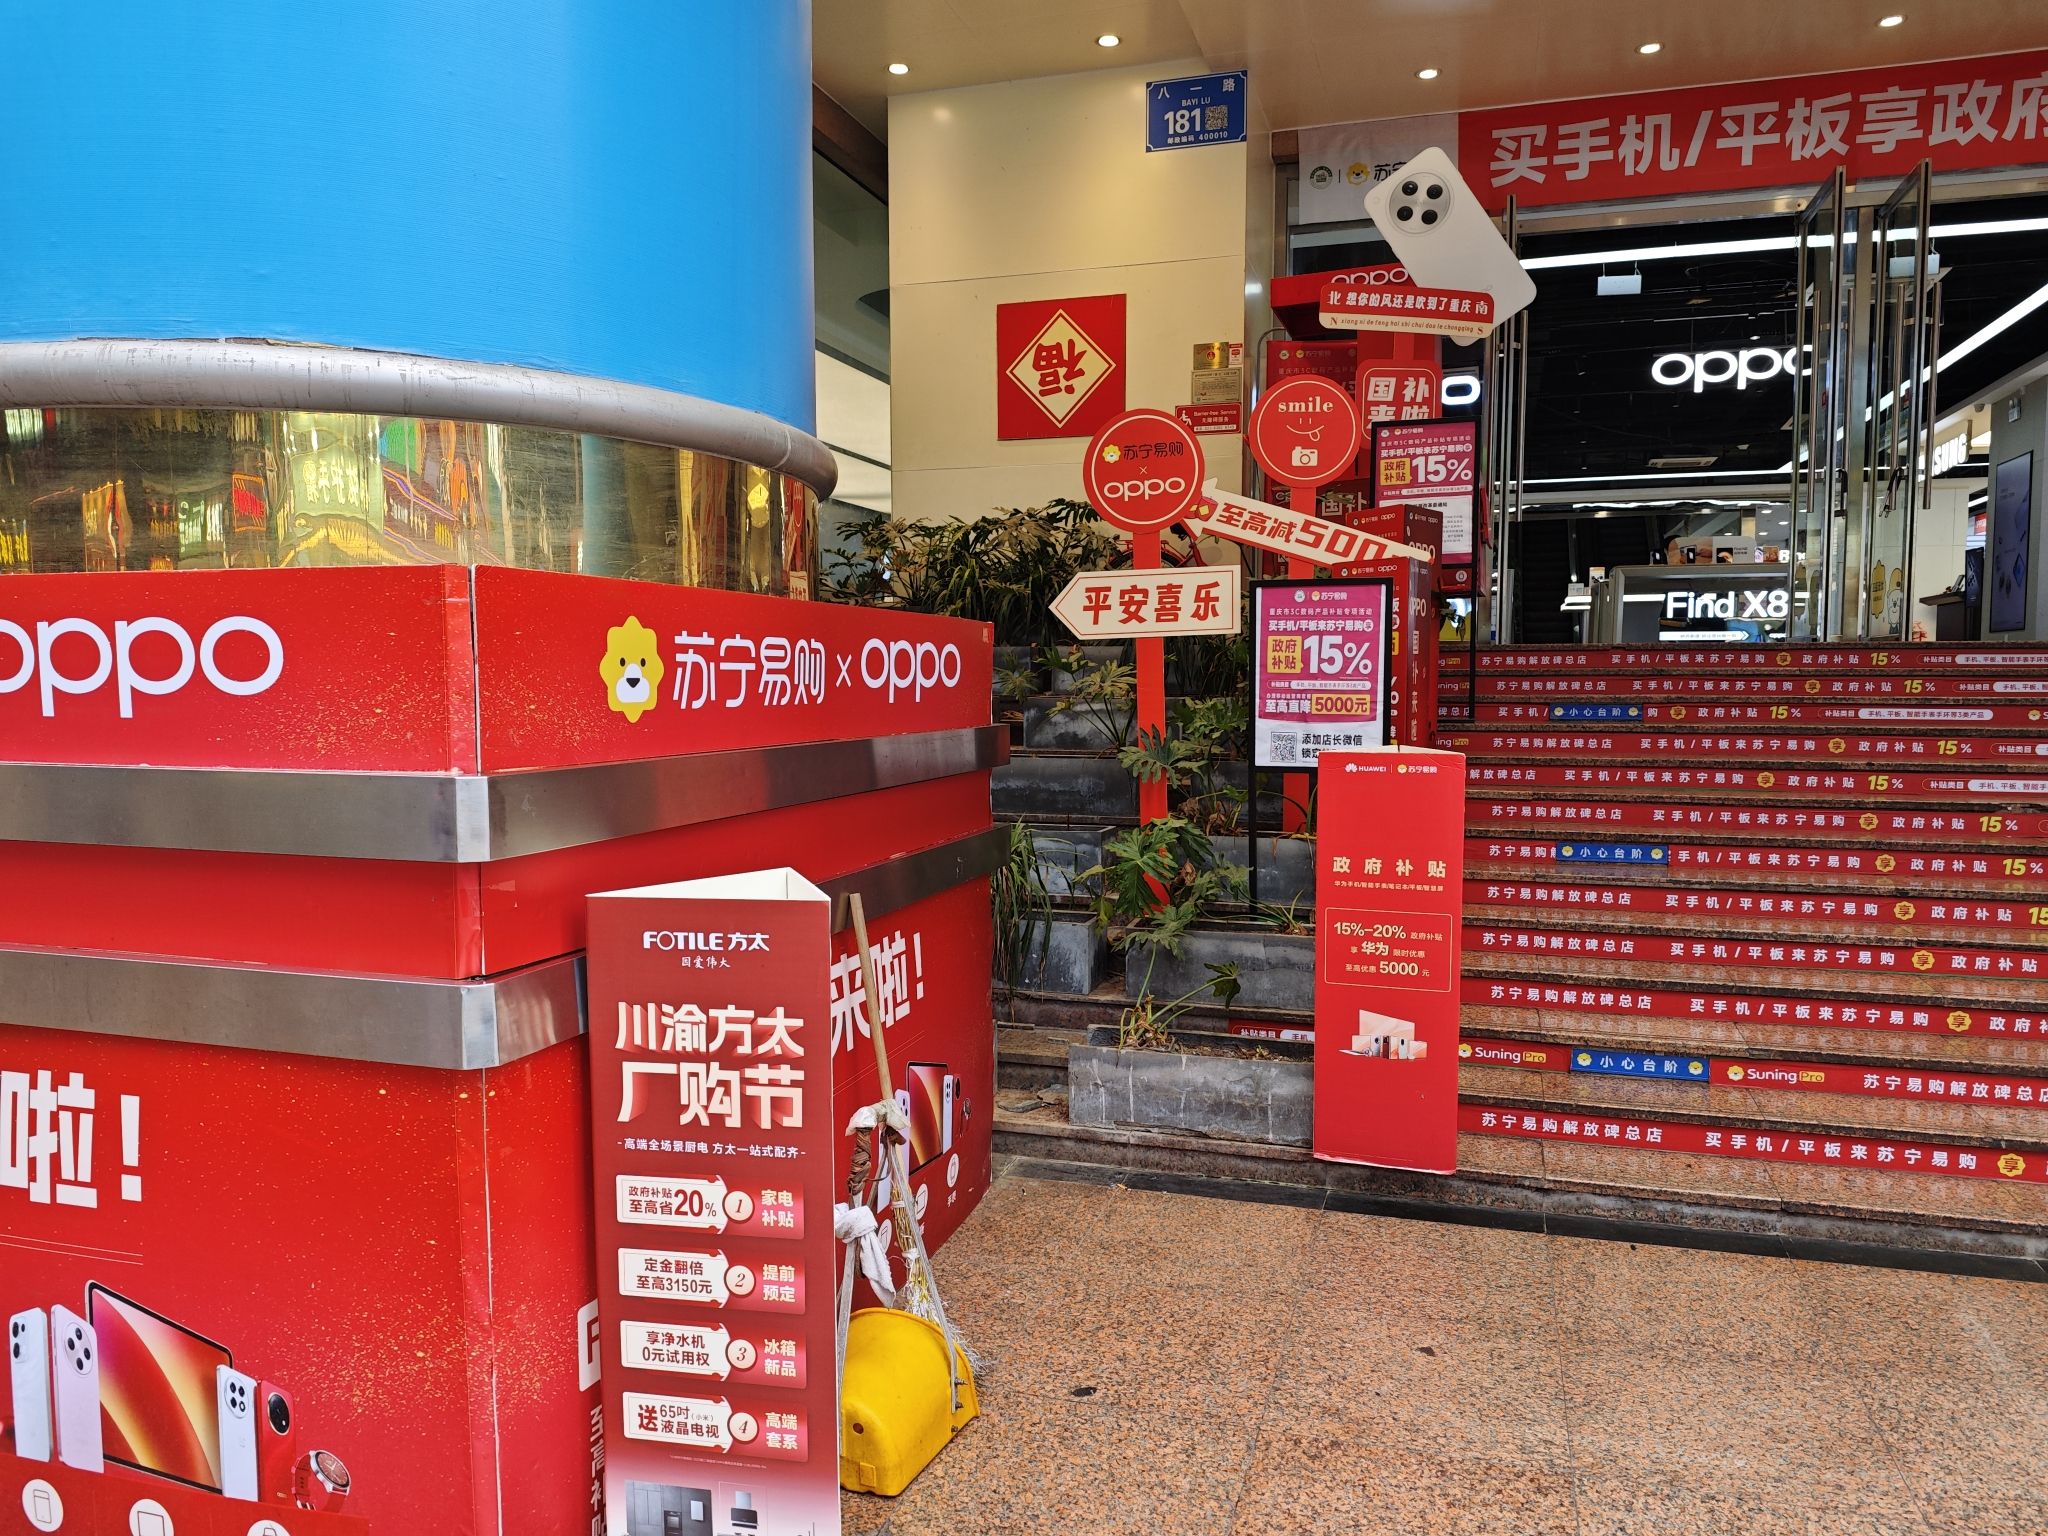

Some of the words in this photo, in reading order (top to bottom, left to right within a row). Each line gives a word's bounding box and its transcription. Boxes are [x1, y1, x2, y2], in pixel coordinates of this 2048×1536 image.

[1157, 77, 1236, 100] 八一路
[1181, 98, 1198, 107] BAYI
[1201, 96, 1211, 105] LU
[1164, 108, 1201, 135] 181
[1489, 72, 2048, 189] 买手机/平板享政府
[1167, 135, 1195, 145] 邮政编码
[1198, 130, 1228, 141] 400010
[1328, 290, 1342, 306] 北
[1346, 291, 1472, 314] 想你的风还是吹到了重庆
[1475, 300, 1489, 316] 南
[1330, 316, 1338, 326] N
[1477, 326, 1485, 335] S
[1032, 338, 1087, 398] 福
[1367, 376, 1430, 403] 国补
[1278, 396, 1334, 413] smile
[1123, 440, 1185, 462] 苏宁易购
[1384, 460, 1406, 471] 政府
[1411, 454, 1472, 483] 15%
[1384, 472, 1406, 482] 补贴
[1103, 477, 1186, 504] oppo
[1378, 564, 1398, 573] oppo
[1083, 581, 1222, 626] 平安喜乐
[1320, 591, 1348, 601] 苏宁易购
[1667, 590, 1735, 619] Find
[1742, 589, 1789, 618] X8
[1269, 607, 1373, 616] 重庆市3C数码产品补贴专项活动
[1268, 620, 1363, 632] 买手机/平板来苏宁易购
[1271, 655, 1297, 670] 补贴
[1272, 638, 1297, 653] 政府
[1303, 634, 1373, 675] 15%
[1482, 655, 1588, 666] 苏宁易购解放碑总店
[1611, 653, 1765, 665] 买手机/平板来苏宁易购
[1802, 654, 1860, 664] 政府补贴
[1870, 653, 1901, 666] 15%
[672, 630, 826, 710] 苏宁易购
[860, 638, 961, 703] oppo
[1496, 680, 1607, 691] 苏宁易购解放碑总店
[1632, 680, 1793, 691] 买手机/平板来苏宁易购
[1832, 681, 1893, 692] 政府补贴
[1904, 679, 1936, 693] 15%
[1265, 699, 1312, 714] 至高直降
[1314, 696, 1368, 713] 5000元
[1569, 707, 1622, 717] 小心台阶
[1698, 706, 1758, 718] 政府补贴
[1769, 706, 1801, 720] 15%
[1824, 709, 1855, 718] 补贴类目
[1301, 733, 1363, 746] 添加店长微信
[1493, 737, 1613, 749] 苏宁易购解放碑总店
[1640, 738, 1816, 751] 买手机/平板来苏宁易购
[1858, 741, 1924, 753] 政府补贴
[1936, 740, 1972, 755] 15%
[1998, 745, 2032, 754] 补贴类目
[1408, 765, 1438, 774] 苏宁易购
[1564, 770, 1744, 785] 买手机/平板来苏宁易购
[1787, 775, 1855, 789] 政府补贴
[1868, 775, 1904, 790] 15%
[1930, 780, 1965, 789] 补贴类目
[1491, 804, 1623, 820] 苏宁易购解放碑总店
[1652, 808, 1845, 827] 买手机/平板来苏宁易购
[1892, 816, 1965, 830] 政府补贴
[1979, 816, 2018, 833] 15%
[1580, 846, 1643, 859] 小心台阶
[1669, 848, 1861, 869] 手机/平板来苏宁易购
[1910, 859, 1987, 873] 政府补贴
[2002, 858, 2044, 876] 15%
[1333, 856, 1447, 878] 政府补贴
[1487, 886, 1632, 906] 苏宁易购解放碑总店
[1665, 894, 1879, 916] 买手机/平板来苏宁易购
[1931, 906, 2013, 922] 政府补贴
[643, 930, 723, 951] FOTILE
[727, 931, 770, 952] 方太
[1410, 931, 1443, 942] 政府补贴
[1361, 941, 1390, 956] 华为
[1393, 949, 1426, 959] 限时优惠
[1482, 932, 1635, 954] 苏宁易购解放碑总店
[1670, 942, 1896, 966] 买手机/平板来苏宁易购
[1951, 955, 2038, 974] 政府补贴
[1345, 963, 1377, 973] 至高优惠
[1379, 960, 1419, 976] 5000
[1421, 969, 1430, 977] 元
[1491, 985, 1653, 1010] 苏宁易购解放碑总店
[1690, 998, 1929, 1027] 买手机/平板来苏宁易购
[614, 1001, 805, 1057] 川渝方太
[1475, 1046, 1521, 1064] Suning
[1523, 1052, 1545, 1063] Pro
[1600, 1056, 1678, 1075] 小心台阶
[1747, 1067, 1798, 1084] Suning
[1800, 1071, 1825, 1083] Pro
[617, 1061, 805, 1130] 厂购节
[1482, 1112, 1663, 1143] 苏宁易购解放碑总店
[1705, 1132, 1977, 1170] 买手机/平板来苏宁易购
[628, 1186, 673, 1199] 政府补贴
[735, 1199, 743, 1214] 1
[761, 1189, 793, 1207] 家电
[761, 1210, 794, 1228] 补贴
[644, 1257, 703, 1275] 定金翻倍
[735, 1273, 745, 1287] 2
[762, 1264, 795, 1282] 提前
[636, 1275, 713, 1294] 至高3150元
[763, 1284, 796, 1302] 预定
[645, 1330, 706, 1349] 享净水机
[737, 1347, 747, 1361] 3
[764, 1338, 796, 1357] 冰箱
[642, 1346, 710, 1366] 0元试用权
[764, 1358, 797, 1377] 新品
[638, 1404, 658, 1432] 送
[660, 1419, 720, 1439] 液晶电视
[738, 1420, 748, 1434] 4
[765, 1411, 798, 1430] 高端
[766, 1431, 798, 1450] 套系
